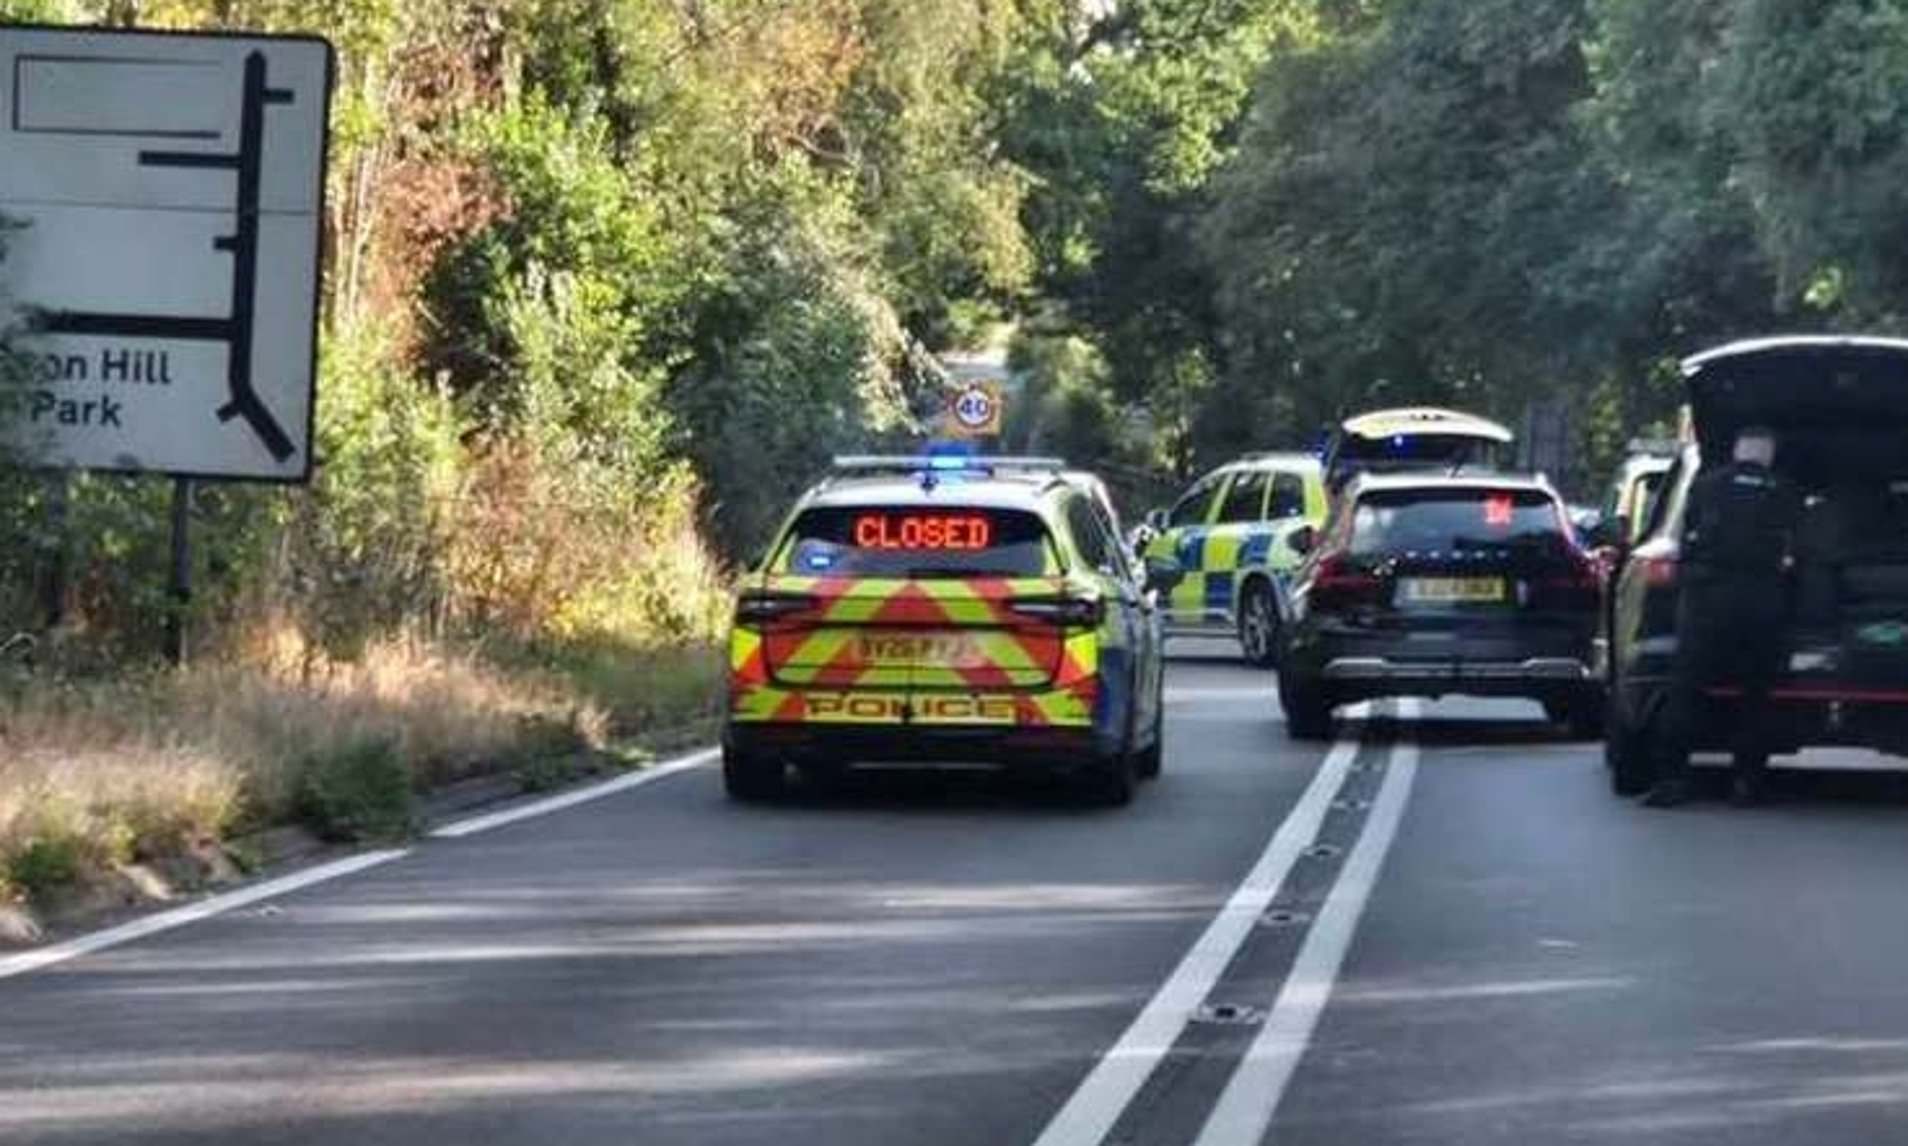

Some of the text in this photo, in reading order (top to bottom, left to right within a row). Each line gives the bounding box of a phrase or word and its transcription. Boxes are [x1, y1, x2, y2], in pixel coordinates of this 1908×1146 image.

[102, 348, 172, 384] Hill
[30, 389, 121, 428] Park
[960, 397, 989, 417] 40
[855, 516, 990, 550] CLOSED
[806, 697, 1016, 720] POLICE
